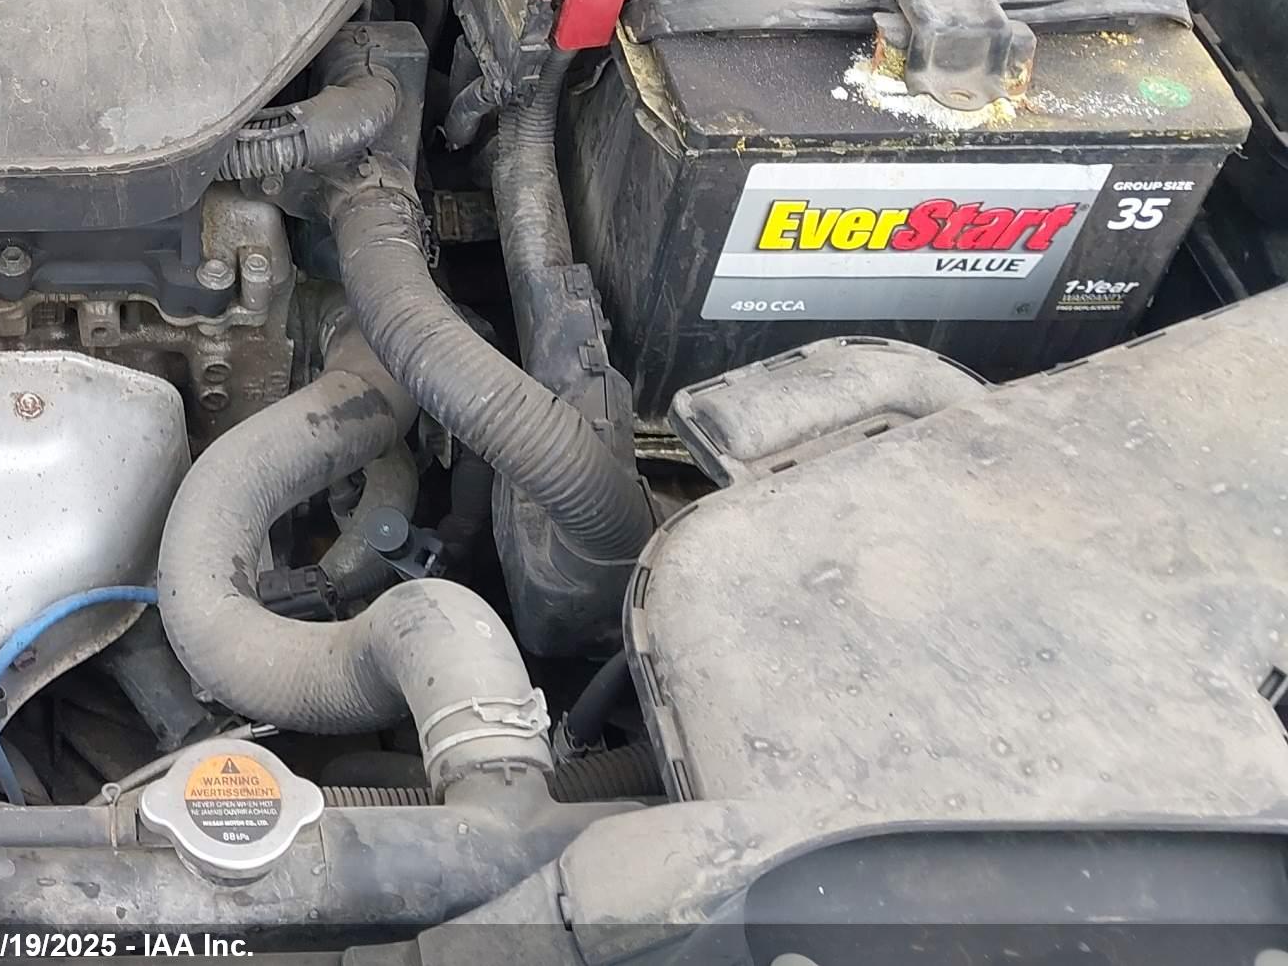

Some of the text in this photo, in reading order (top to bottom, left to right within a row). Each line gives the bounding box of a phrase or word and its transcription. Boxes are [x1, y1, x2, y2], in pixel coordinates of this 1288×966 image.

[1113, 181, 1195, 191] GROUP SIZE
[1107, 197, 1171, 230] 35
[757, 199, 1079, 252] EverStart
[935, 257, 1025, 273] VALUE
[1065, 280, 1140, 293] 1-Year
[731, 300, 806, 312] 490 CCA
[203, 777, 260, 786] WARNING
[191, 788, 274, 797] AVERTISSEMENT
